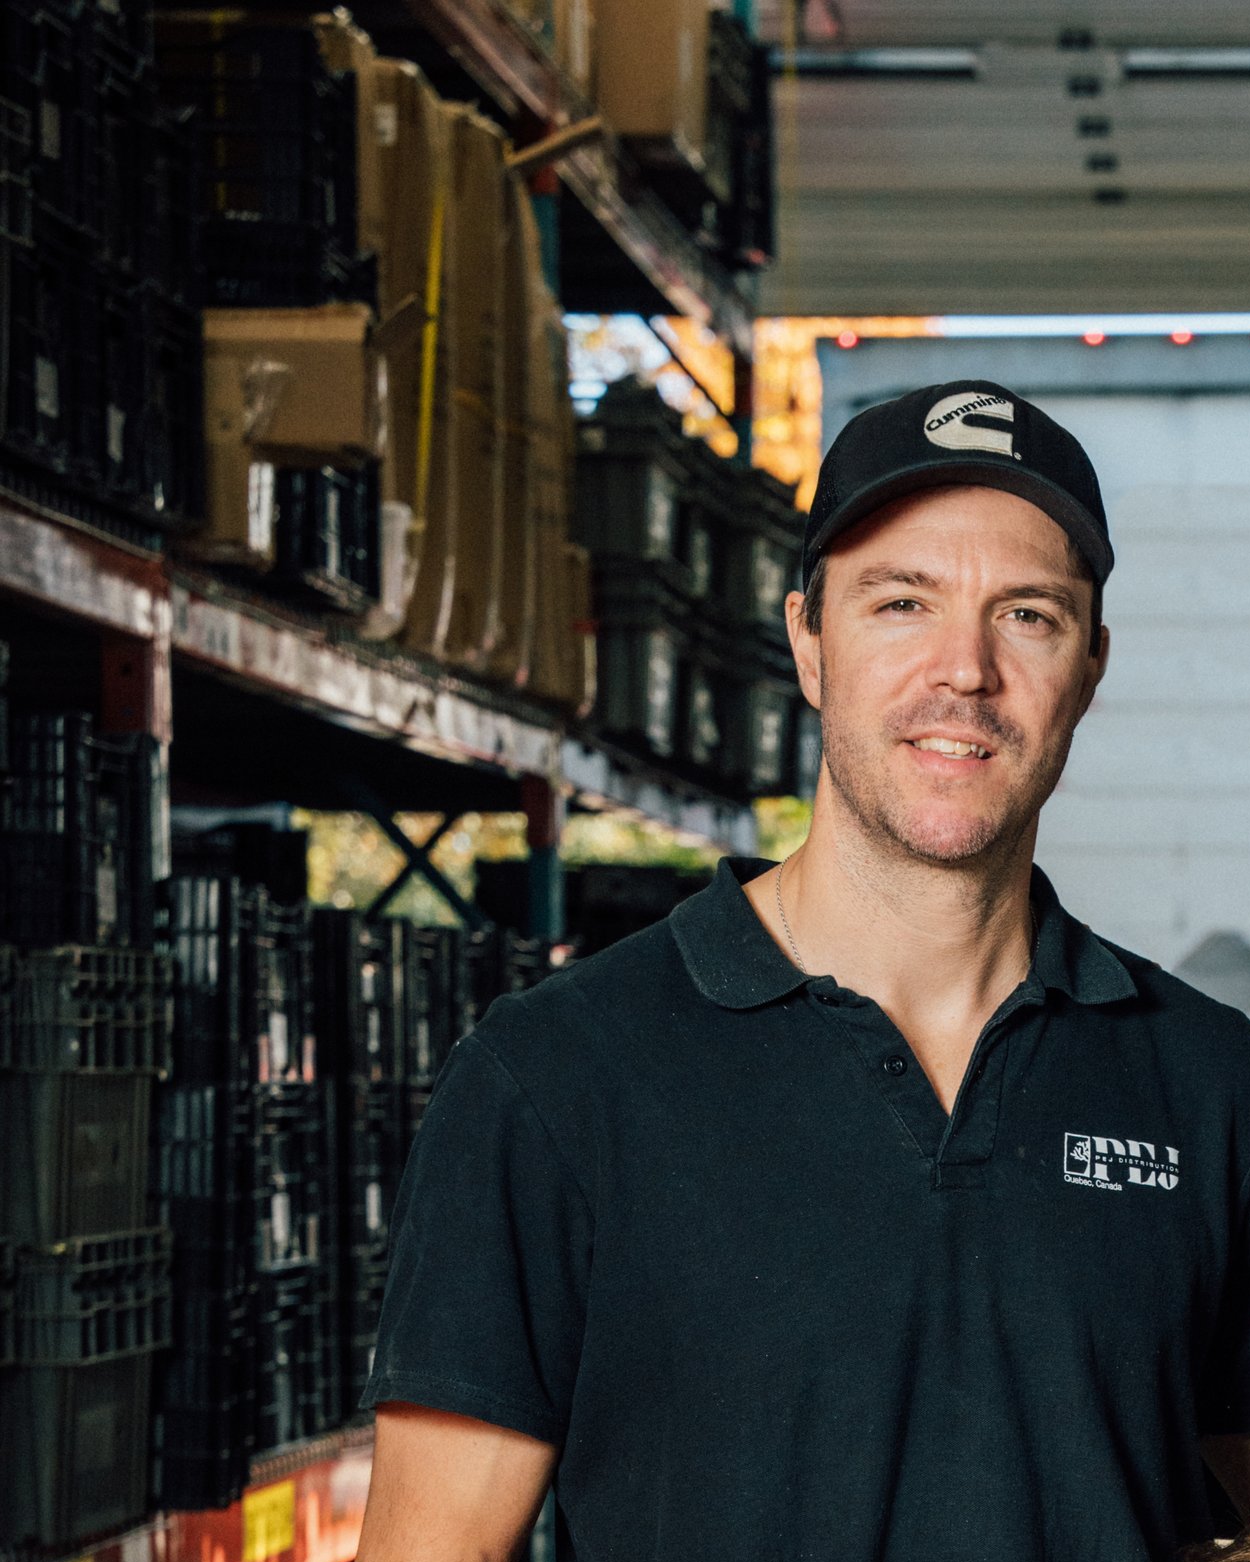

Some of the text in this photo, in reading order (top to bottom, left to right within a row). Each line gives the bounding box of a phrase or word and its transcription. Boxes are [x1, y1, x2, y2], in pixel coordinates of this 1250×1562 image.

[1095, 1155, 1179, 1173] PEJ DISTRIBUTION
[1096, 1180, 1122, 1191] Canada
